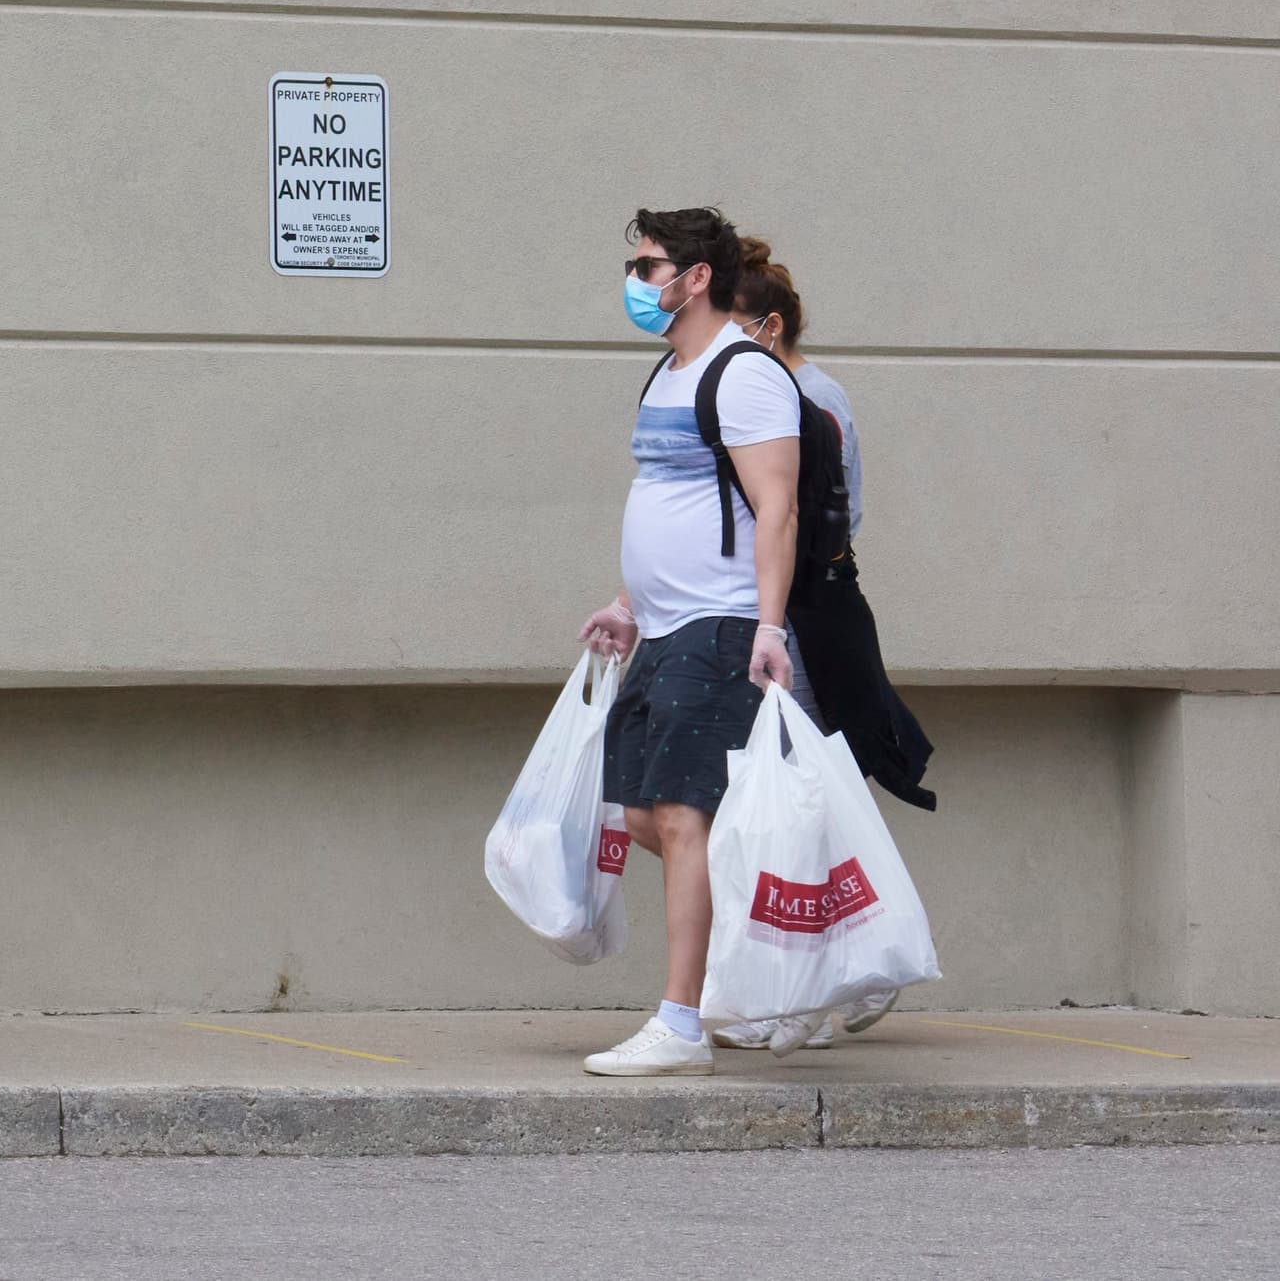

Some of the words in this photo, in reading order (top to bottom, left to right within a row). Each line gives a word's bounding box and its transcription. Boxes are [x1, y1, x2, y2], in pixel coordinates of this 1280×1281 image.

[277, 90, 320, 101] PRIVATE
[324, 91, 380, 102] PROPERTY
[313, 113, 346, 134] NO
[278, 146, 381, 169] PARKING
[278, 179, 382, 202] ANYTIME
[312, 213, 351, 222] VEHICLES
[281, 223, 300, 231] WILL
[302, 223, 313, 232] BE
[315, 224, 348, 233] TAGGED
[349, 225, 380, 233] AND/OR
[299, 234, 327, 243] TOWED
[353, 236, 363, 244] AT
[293, 245, 330, 254] OWNER'S
[332, 247, 368, 255] EXPENSE
